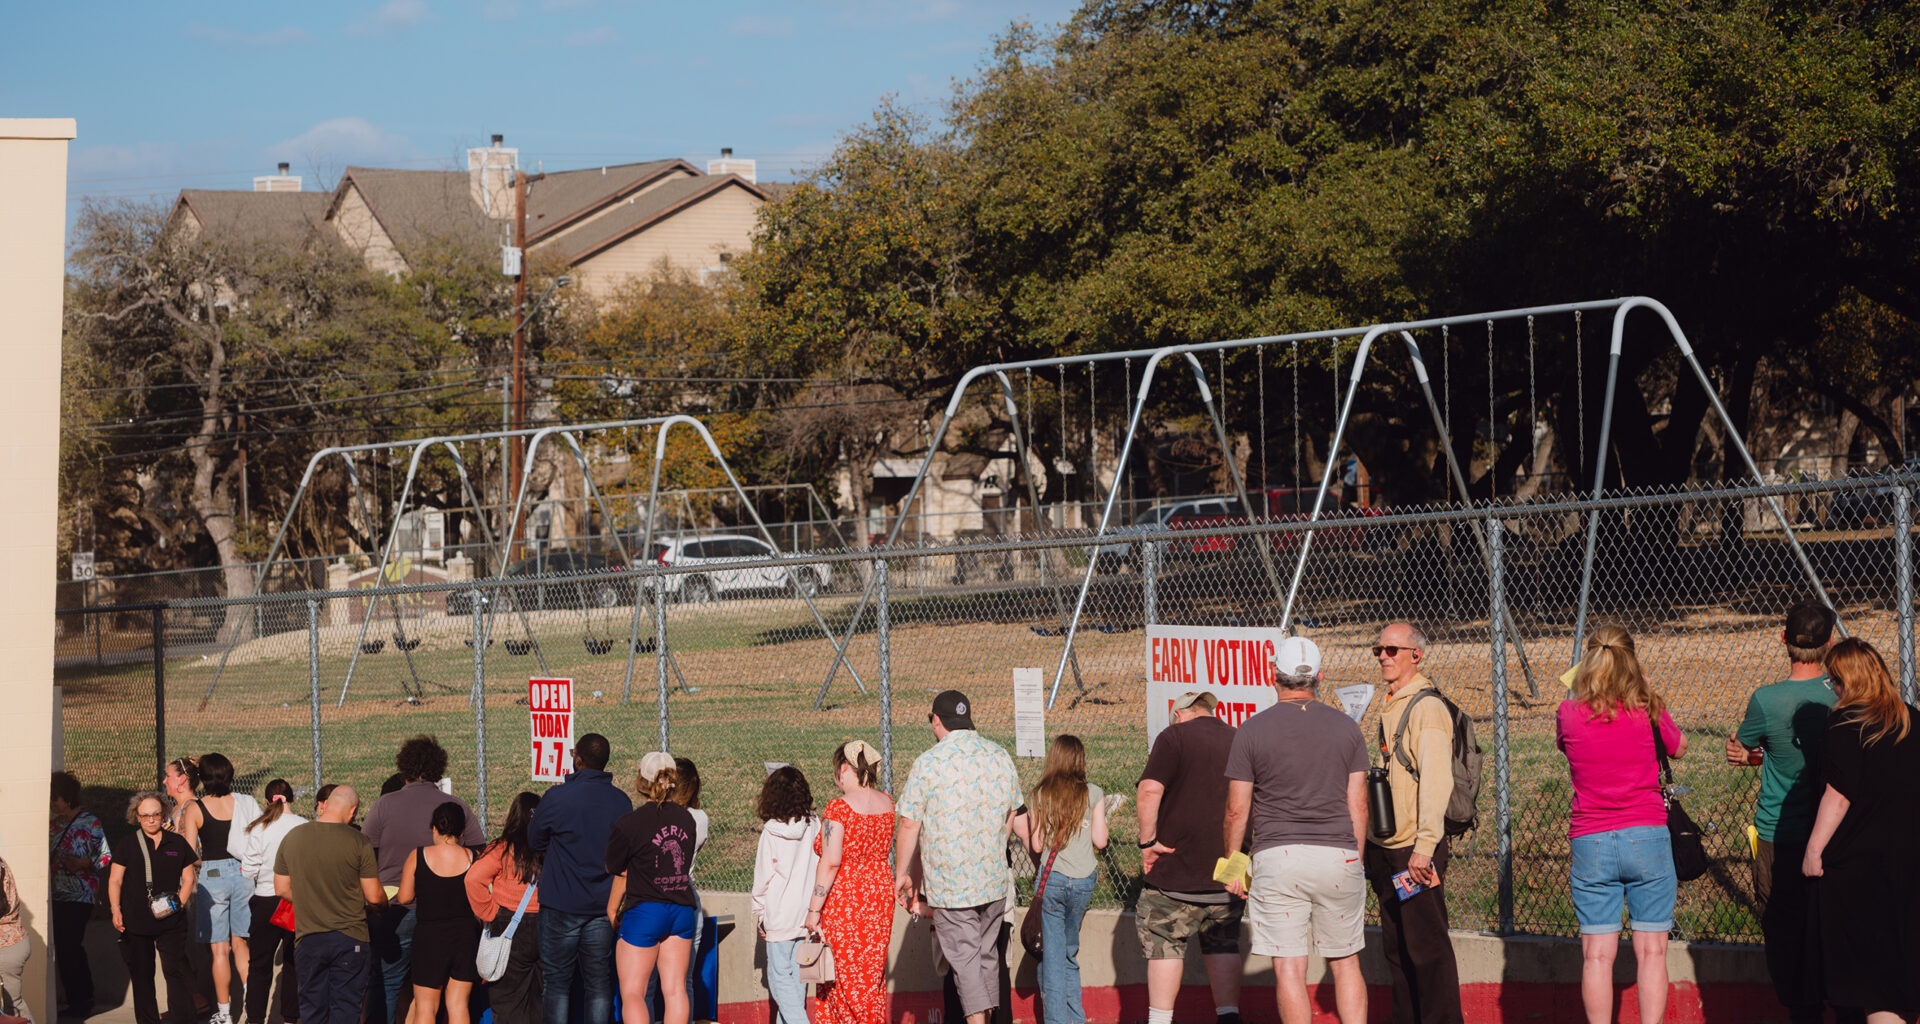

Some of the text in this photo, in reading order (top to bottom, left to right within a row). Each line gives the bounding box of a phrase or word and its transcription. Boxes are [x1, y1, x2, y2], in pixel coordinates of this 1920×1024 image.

[76, 566, 93, 578] 30
[1152, 637, 1275, 687] EARLY VOTING
[531, 683, 568, 709] OPEN
[532, 713, 569, 738] TODAY
[533, 741, 543, 775] 7
[553, 741, 564, 776] 7
[652, 824, 689, 847] MERIT
